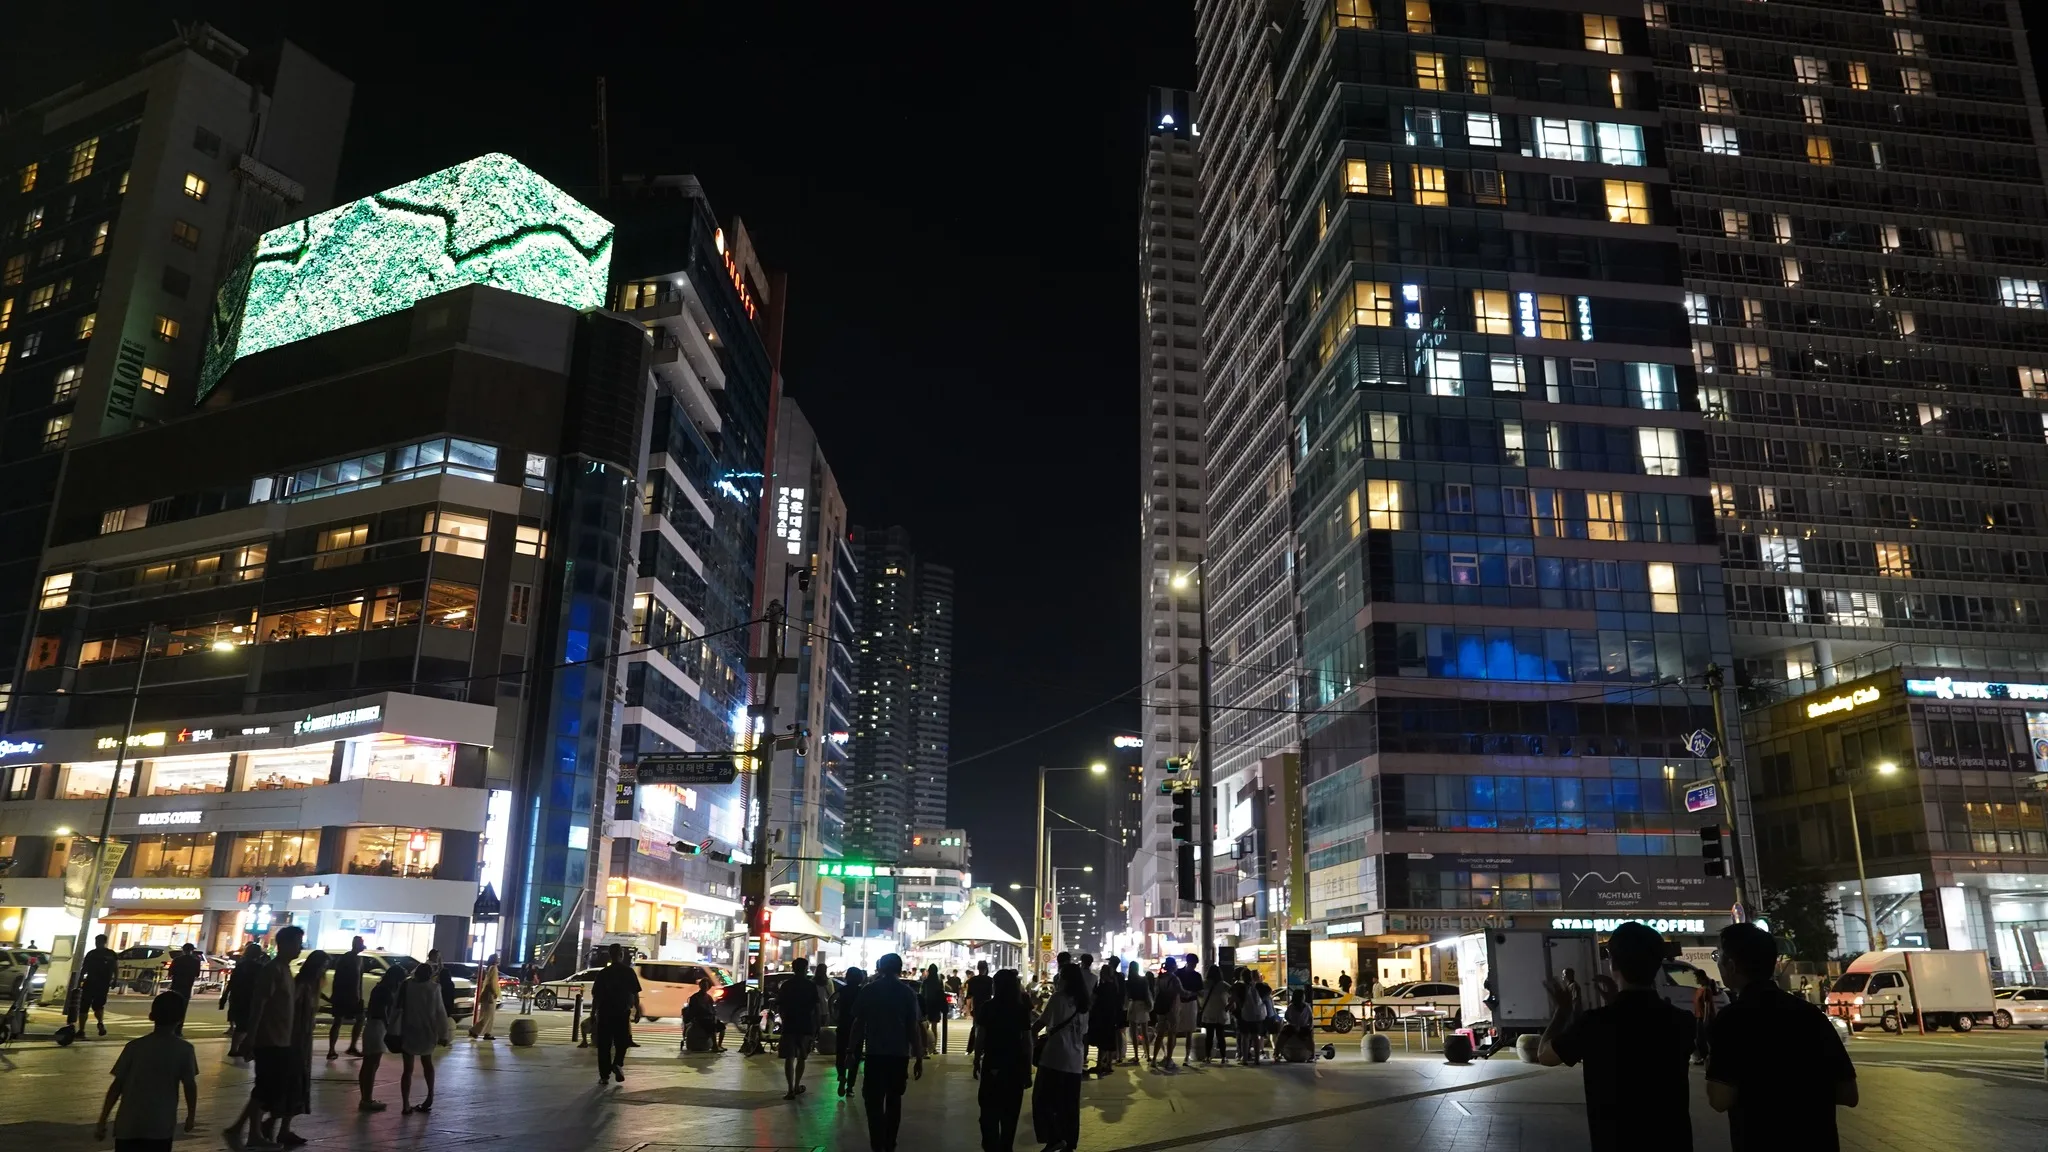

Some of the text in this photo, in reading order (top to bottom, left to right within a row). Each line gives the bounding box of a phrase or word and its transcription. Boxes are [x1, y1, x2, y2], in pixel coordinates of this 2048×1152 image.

[107, 343, 145, 419] HOTEL
[787, 488, 804, 554] 해운대호텔
[1853, 686, 1880, 705] Club
[656, 763, 715, 775] 해운대해변로
[1410, 916, 1506, 931] HOTEL ELYSIA
[1647, 919, 1705, 932] COFFEE
